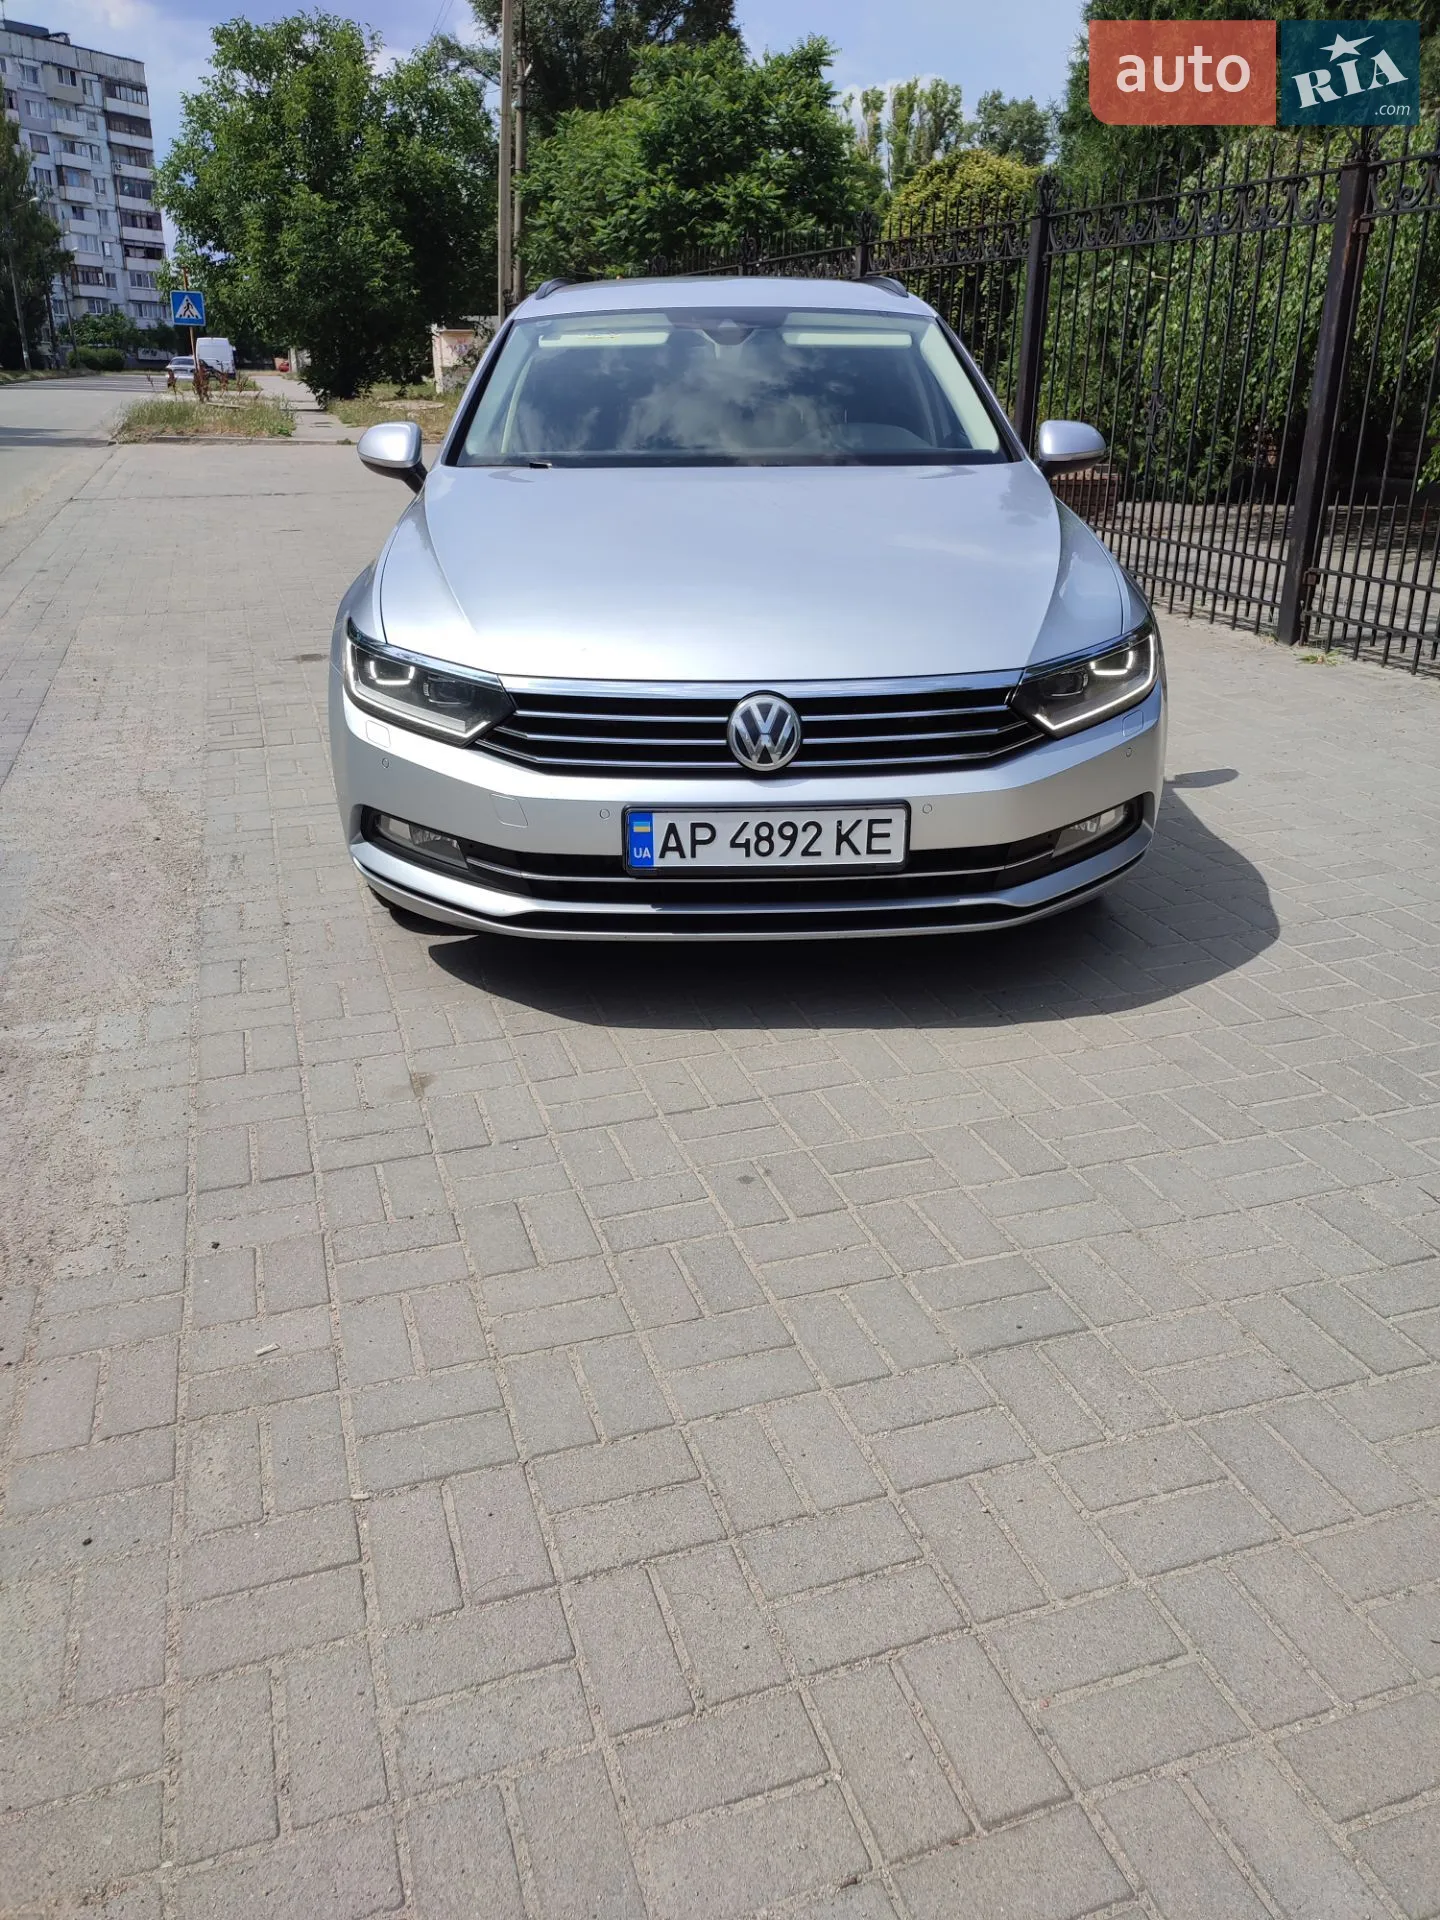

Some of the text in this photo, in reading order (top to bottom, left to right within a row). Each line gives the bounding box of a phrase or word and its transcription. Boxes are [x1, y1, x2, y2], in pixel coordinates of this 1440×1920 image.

[633, 818, 893, 859] UA AP 4892 KE
